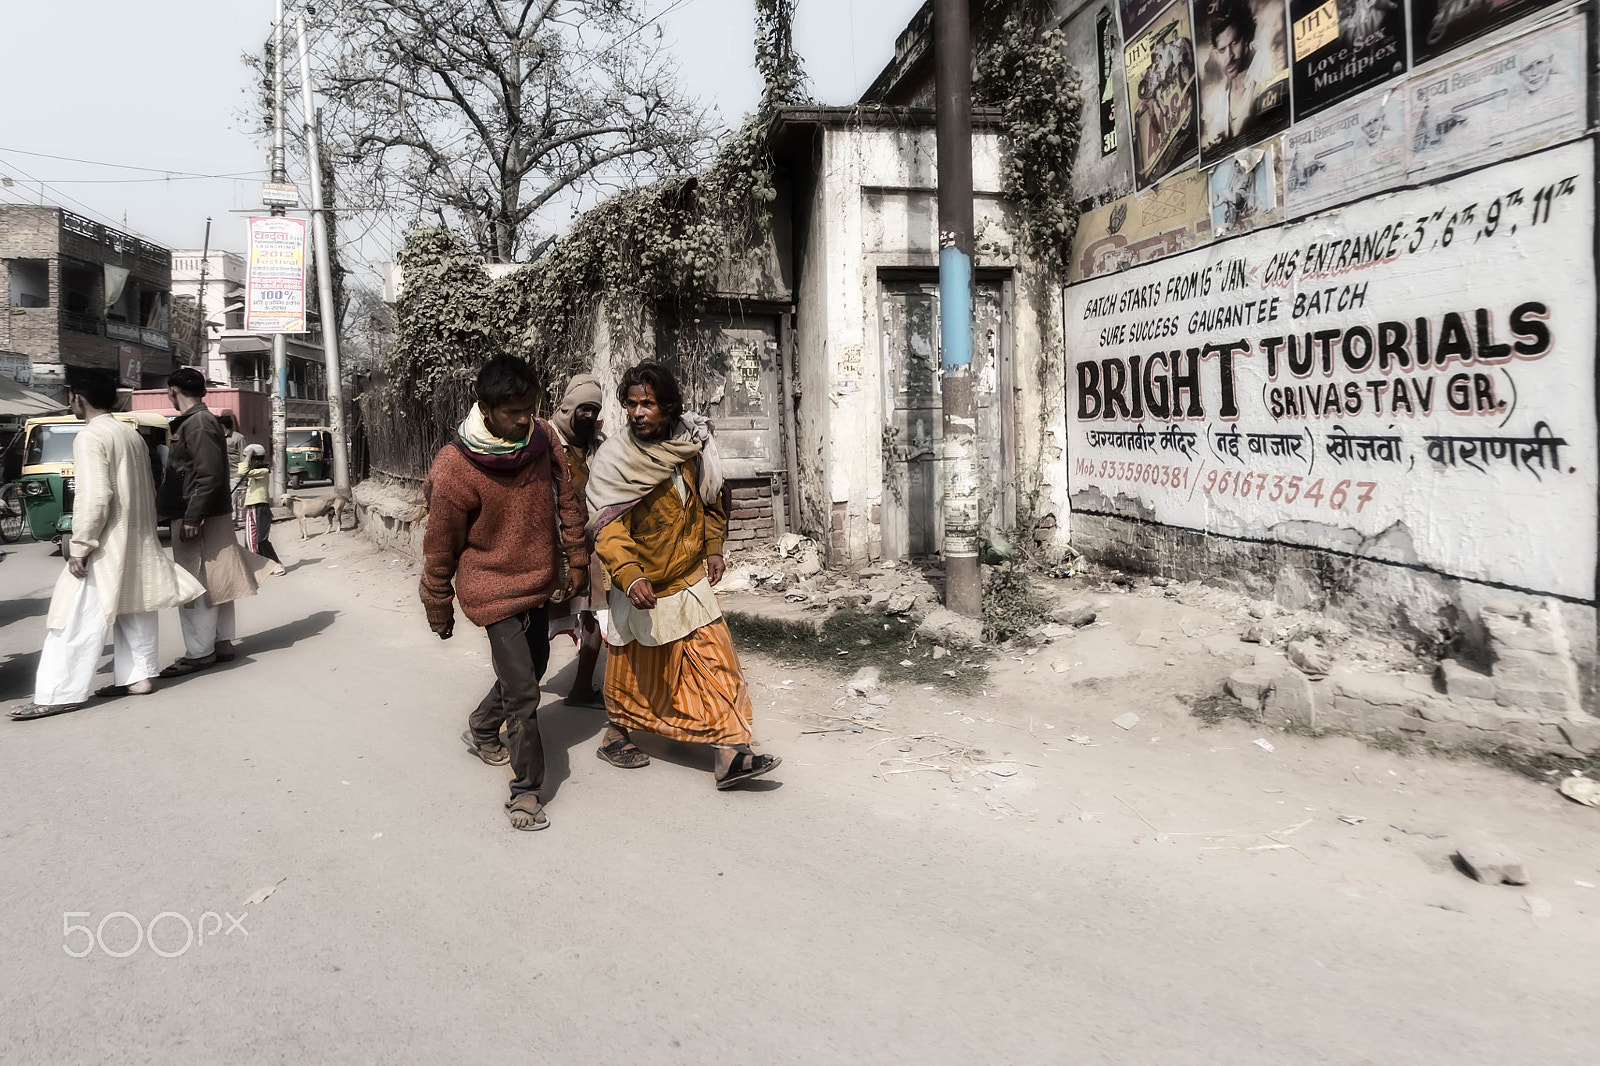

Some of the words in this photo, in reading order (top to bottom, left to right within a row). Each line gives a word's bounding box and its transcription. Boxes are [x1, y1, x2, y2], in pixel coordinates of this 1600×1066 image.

[1296, 6, 1336, 41] JHV
[1126, 43, 1150, 68] JHV
[1308, 48, 1348, 77] Love
[1353, 27, 1386, 52] Sex
[1314, 40, 1398, 92] Multiplex
[259, 250, 294, 258] 2012
[260, 290, 296, 301] 100%
[1083, 293, 1118, 320] BATCH
[1119, 281, 1161, 313] STARTS
[1165, 271, 1199, 303] FROM
[1221, 257, 1249, 292] JAN.
[1262, 249, 1300, 287] CHS
[1100, 324, 1126, 347] SURE
[1128, 315, 1179, 343] SUCCESS
[1187, 297, 1280, 334] GAURANTEE
[1291, 281, 1369, 319] BATCH
[1076, 339, 1251, 421] BRIGHT
[1260, 301, 1552, 378] TUTORIALS
[1263, 375, 1434, 423] (SRIVASTAV
[1446, 367, 1517, 428] GR.)
[1158, 423, 1200, 462] मंदिर
[1247, 426, 1314, 475] बाजार)
[1203, 469, 1378, 513] 9616735467
